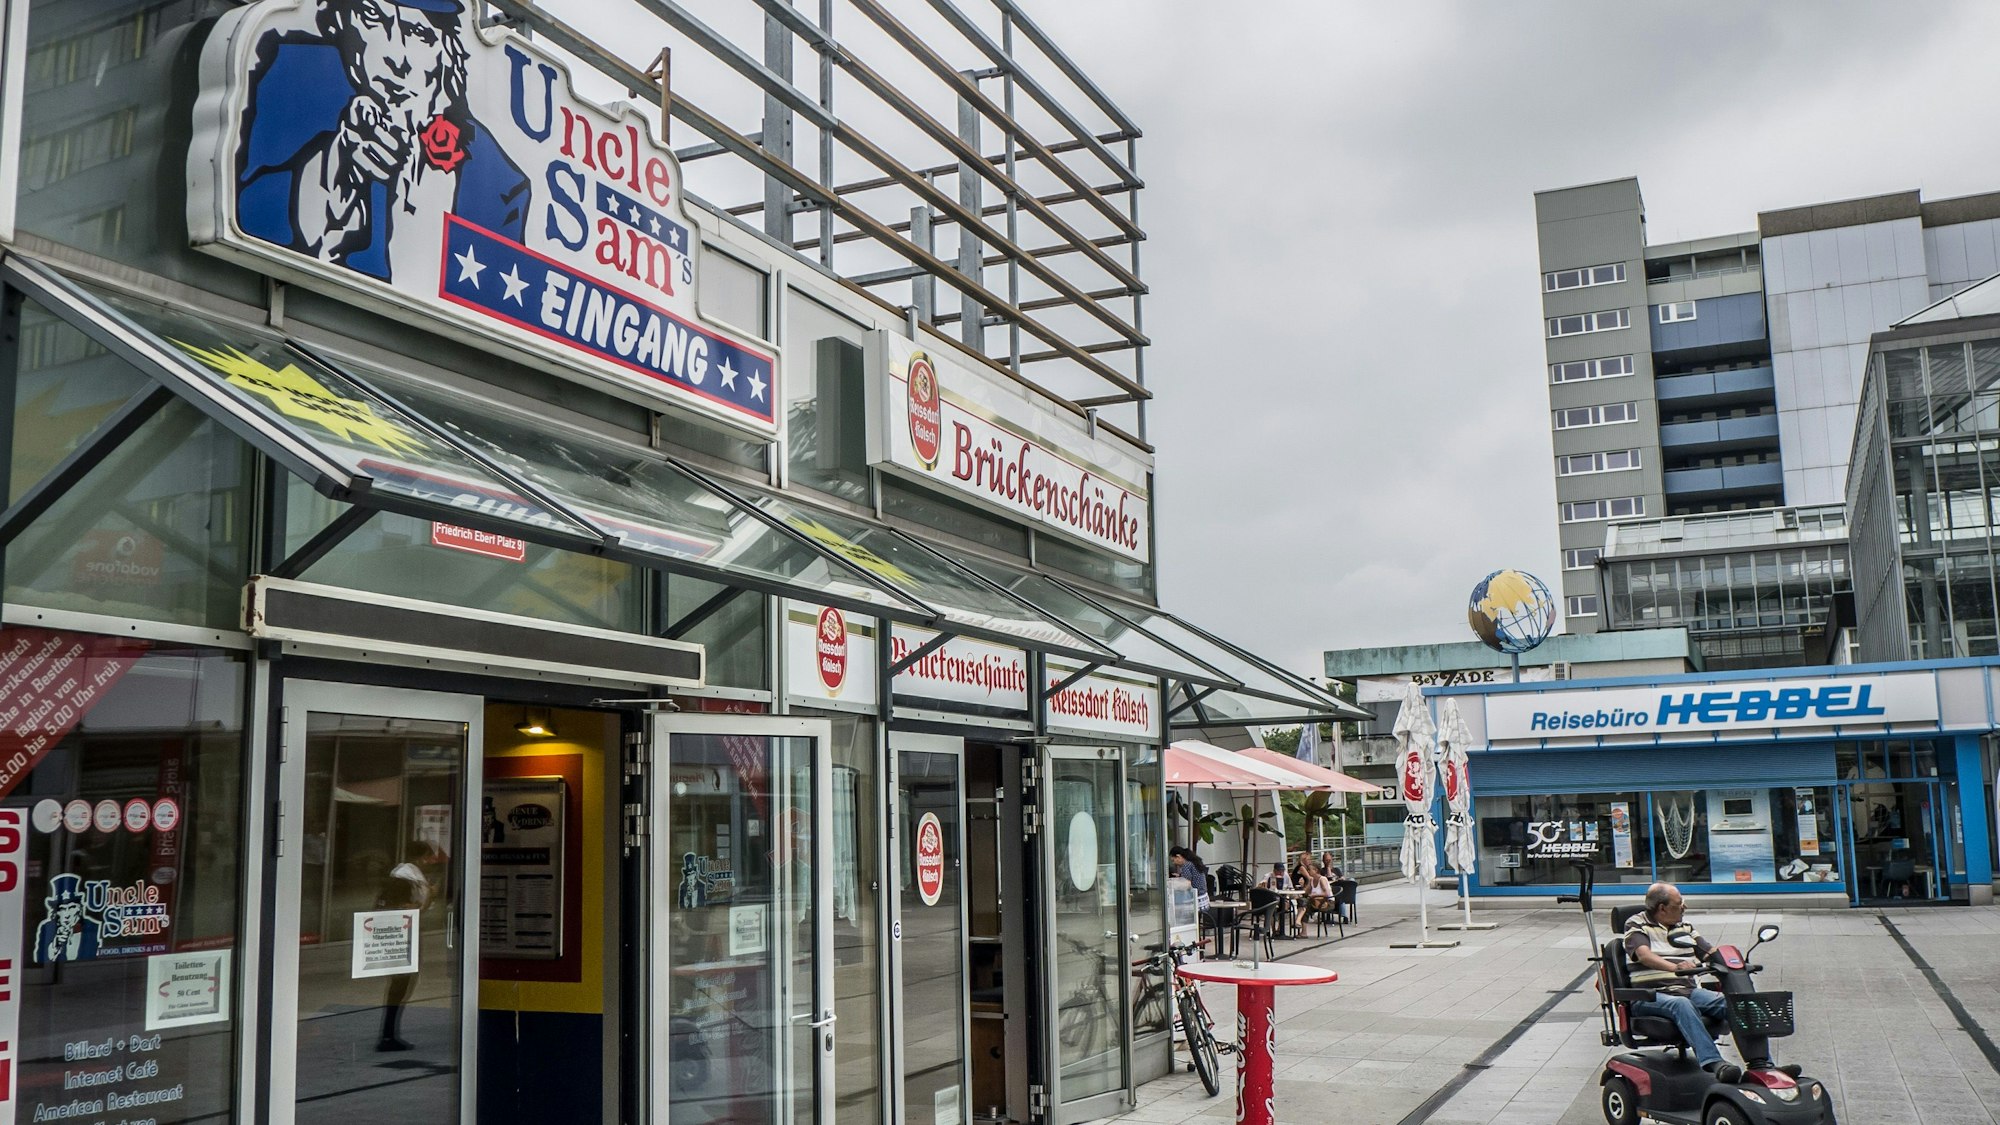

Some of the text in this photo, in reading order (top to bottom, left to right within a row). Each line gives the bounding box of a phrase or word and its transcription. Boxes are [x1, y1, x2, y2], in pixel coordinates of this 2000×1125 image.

[504, 44, 670, 207] Uncle
[541, 270, 708, 385] EINGANG
[952, 420, 1138, 551] Brückenschänke
[436, 522, 522, 550] Friedrich Ebert Platz 9
[0, 638, 31, 674] nfach
[0, 636, 63, 703] erikanische
[17, 692, 35, 708] in
[31, 643, 84, 693] Bestform
[0, 752, 28, 790] 6.00
[24, 734, 47, 756] bis
[44, 704, 74, 736] 5.00
[71, 685, 96, 708] Uhr
[94, 660, 121, 687] früh
[15, 677, 78, 738] täglich von
[1112, 686, 1149, 732] Kölsch
[1531, 684, 1886, 731] Reisebüro HEBBEL
[1541, 843, 1599, 853] HEBBEL
[85, 880, 159, 912] Uncle
[122, 946, 146, 955] DRINKS
[153, 944, 166, 952] FUN
[64, 1038, 112, 1061] Billard
[130, 1034, 161, 1052] Dart
[64, 1059, 159, 1090] Internet Café
[33, 1083, 184, 1122] American Restaurant
